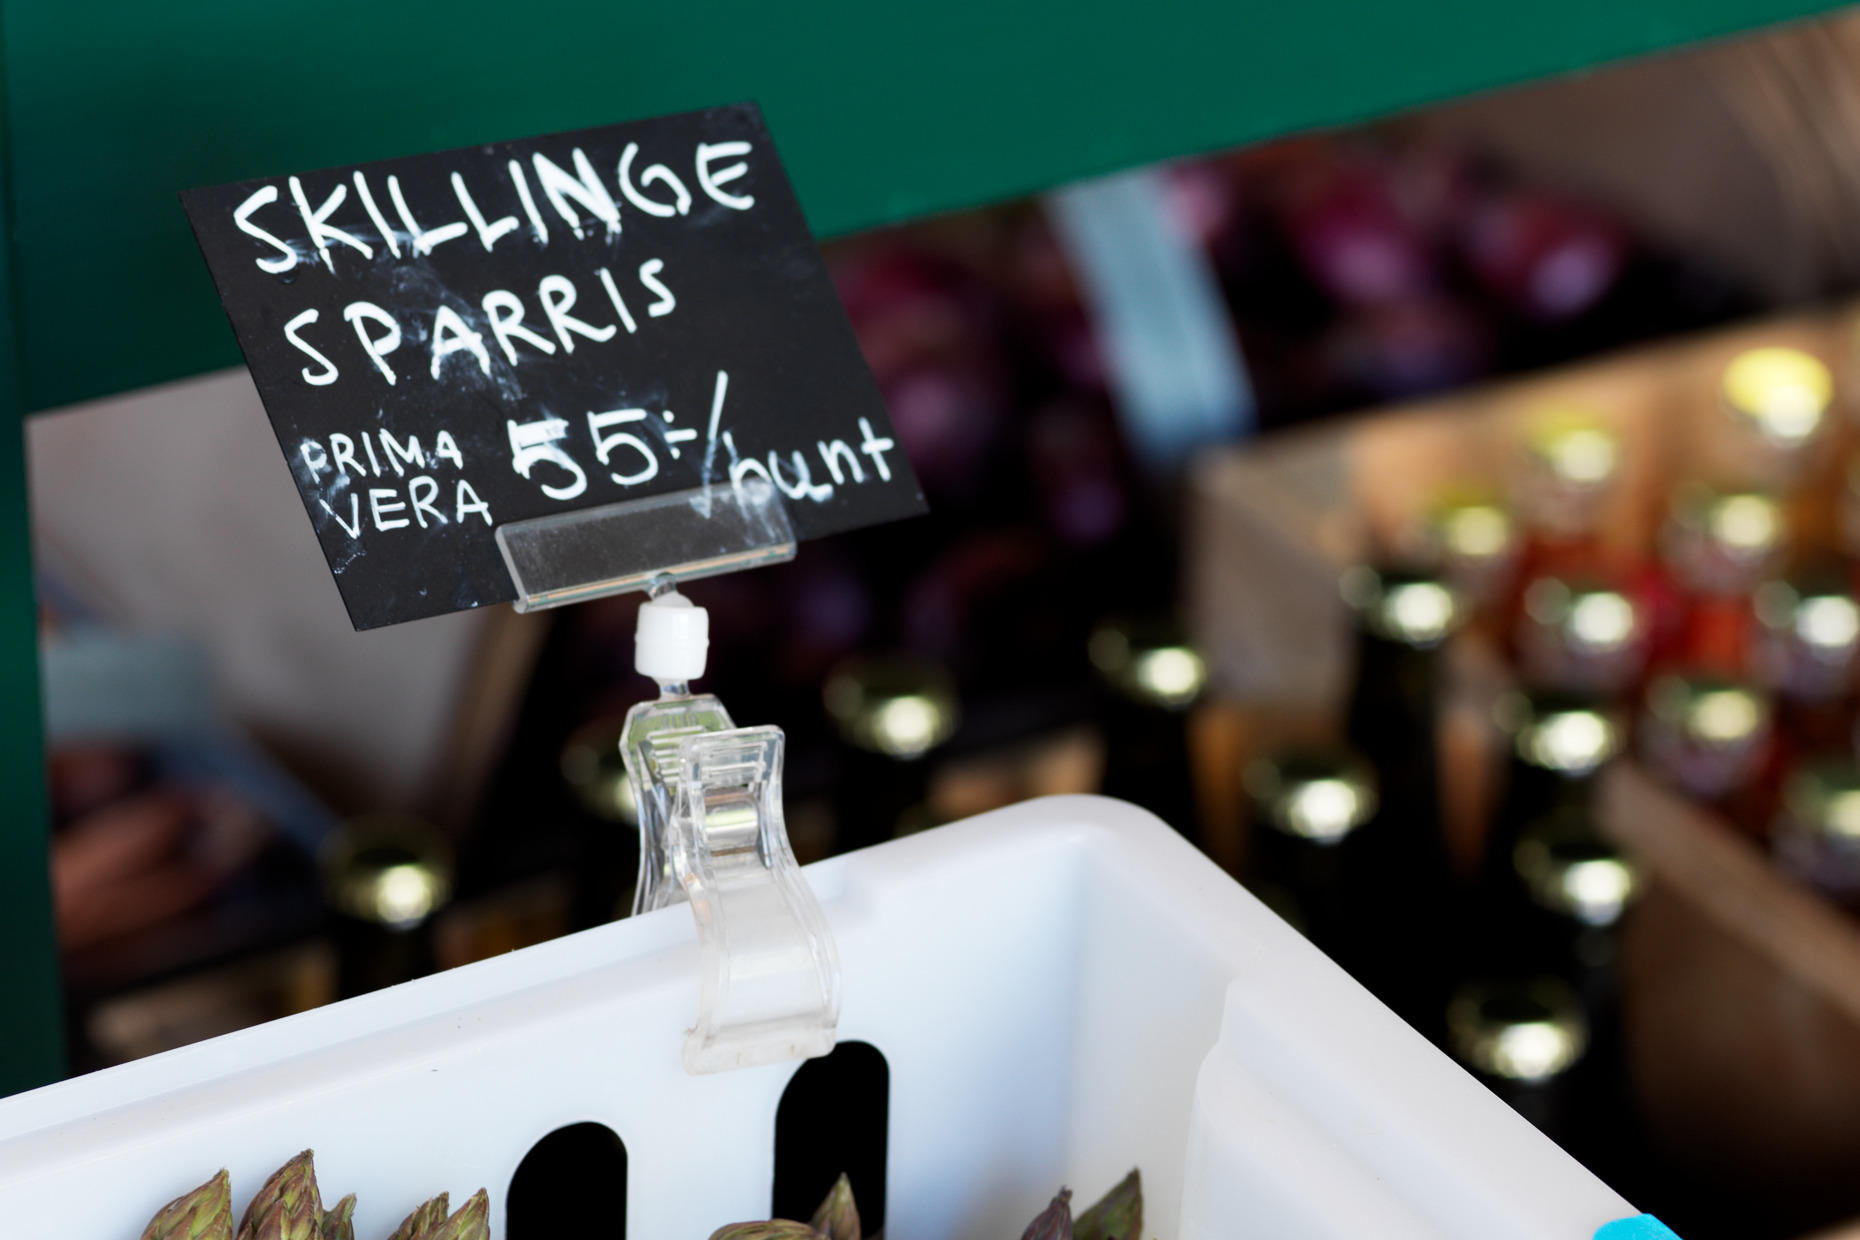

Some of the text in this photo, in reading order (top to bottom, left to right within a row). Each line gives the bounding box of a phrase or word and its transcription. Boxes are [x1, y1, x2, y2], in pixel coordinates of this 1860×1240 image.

[234, 141, 754, 274] SKILLINGE
[285, 259, 675, 386] SPARRIS
[301, 430, 463, 483] PRIMA
[320, 475, 493, 540] VERA
